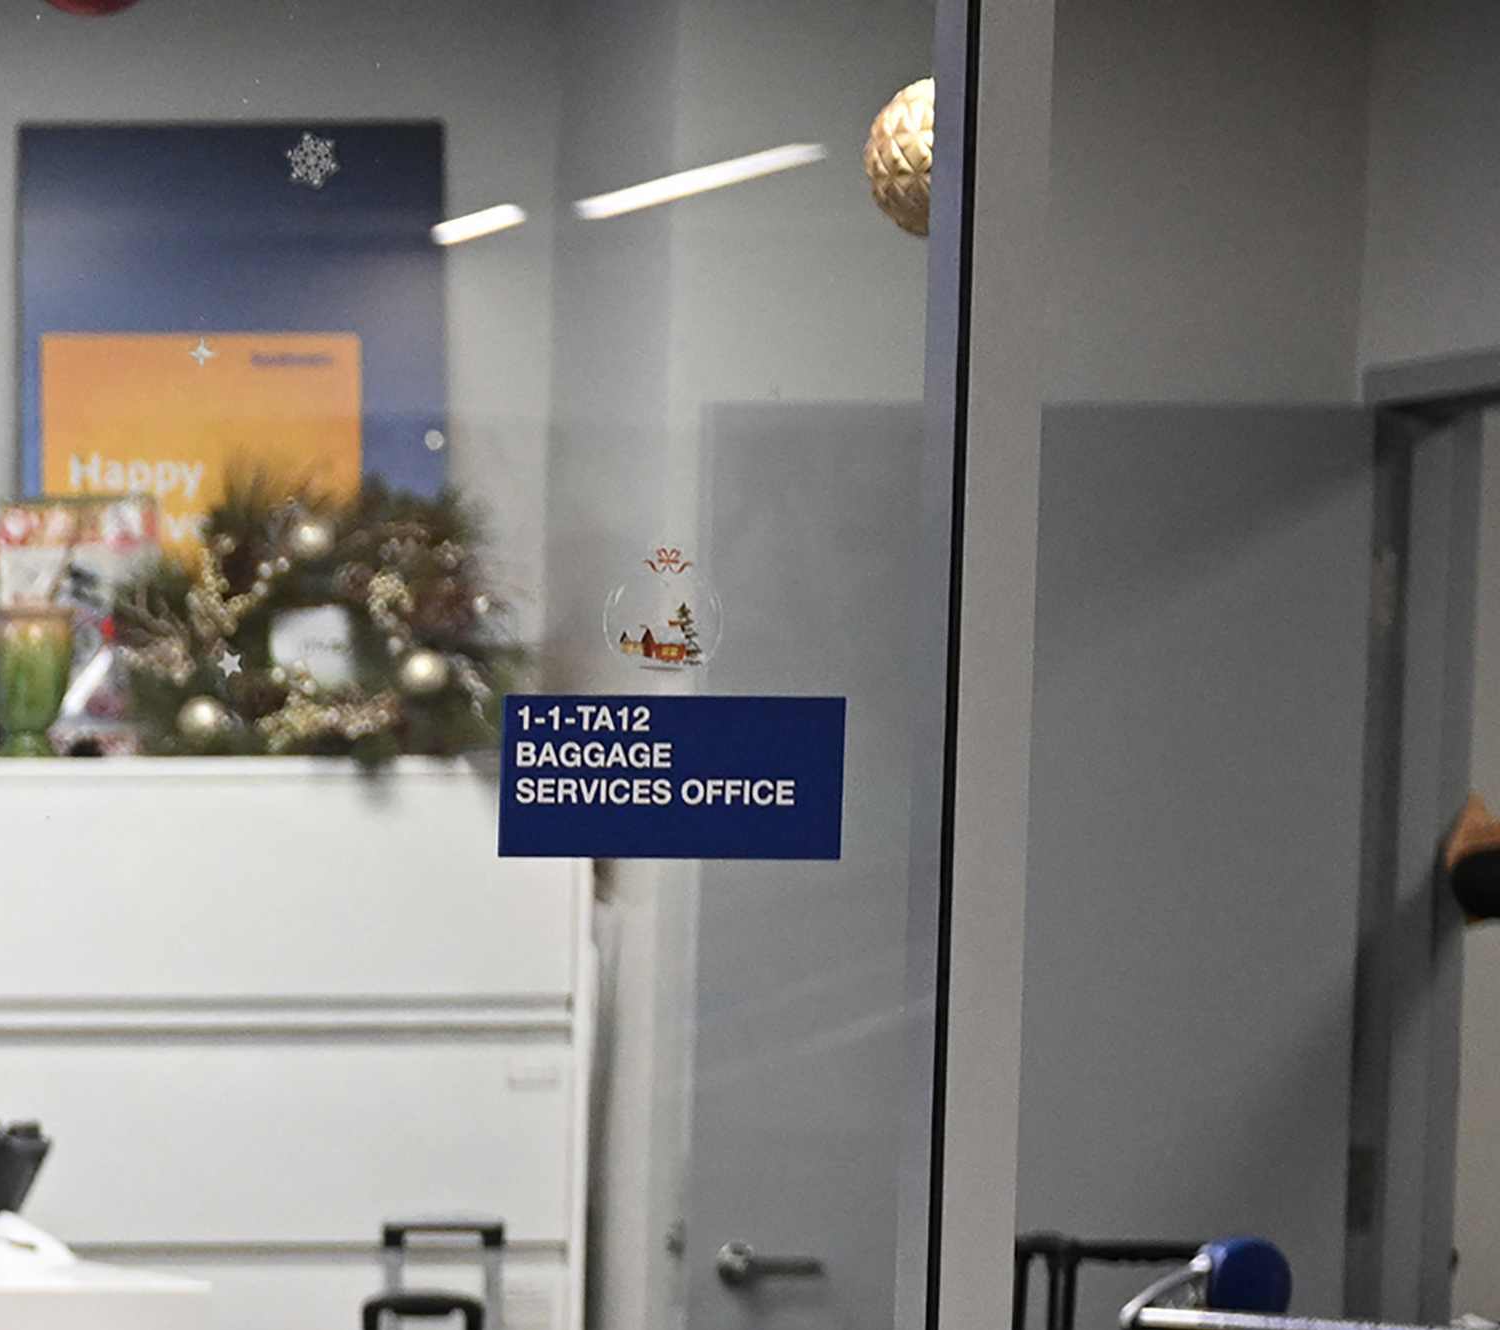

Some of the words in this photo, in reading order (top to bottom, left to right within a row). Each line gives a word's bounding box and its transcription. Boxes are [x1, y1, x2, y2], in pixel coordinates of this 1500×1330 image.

[68, 454, 204, 496] Happy
[516, 706, 650, 732] 1-1-TA12
[515, 741, 672, 769] BAGGAGE
[515, 778, 672, 806] SERVICES
[681, 779, 796, 806] OFFICE
